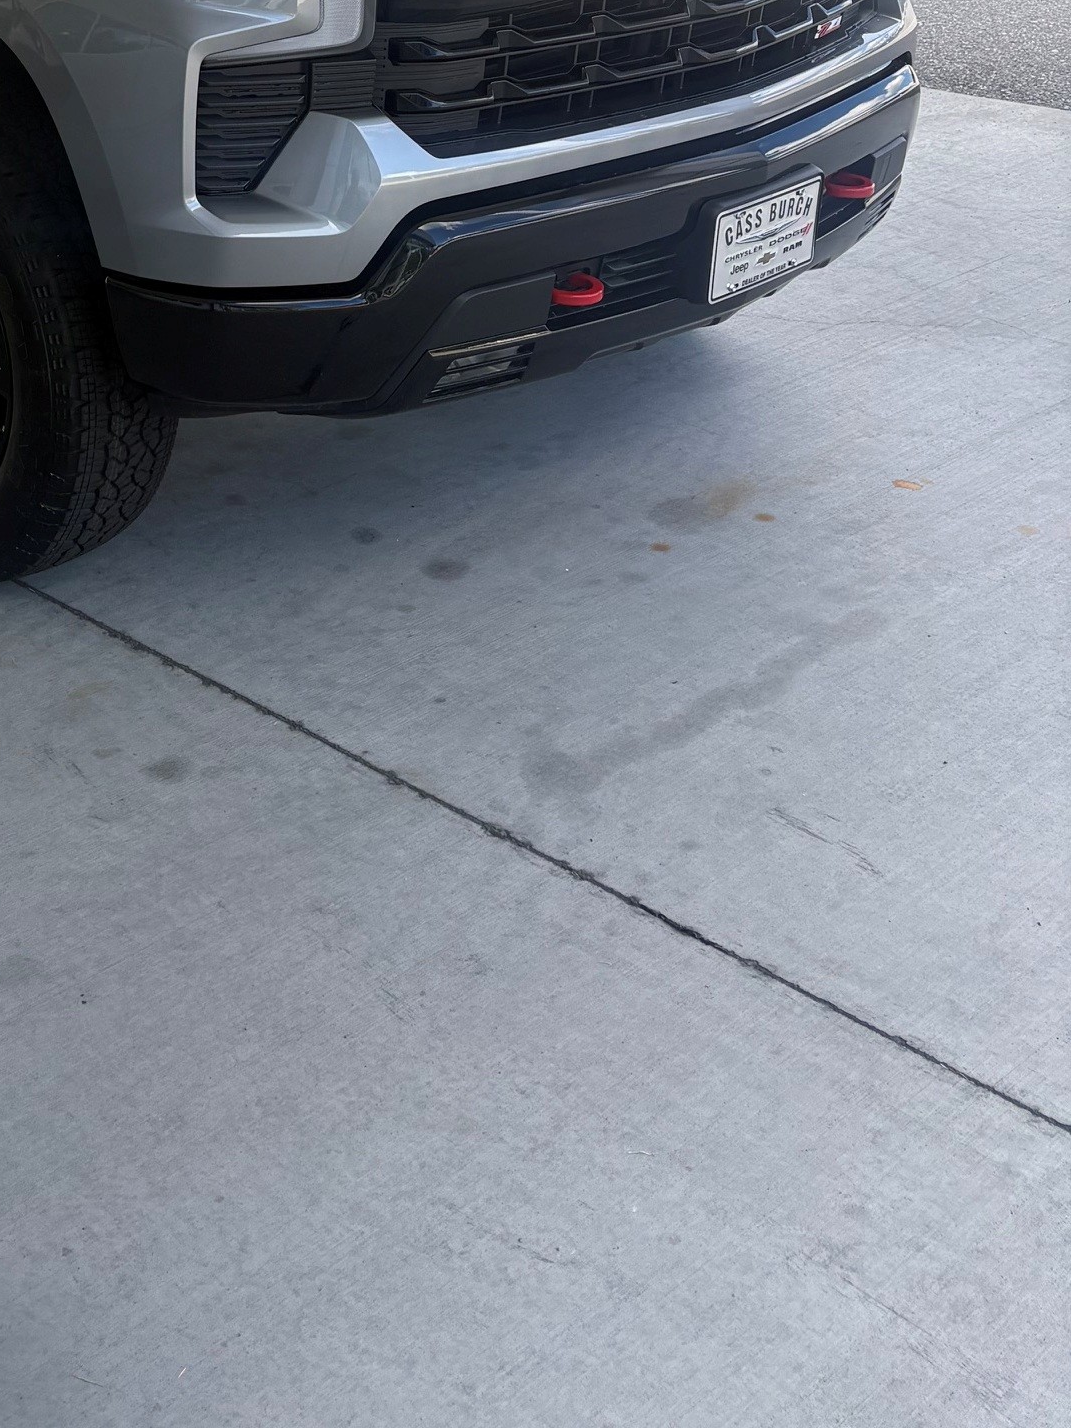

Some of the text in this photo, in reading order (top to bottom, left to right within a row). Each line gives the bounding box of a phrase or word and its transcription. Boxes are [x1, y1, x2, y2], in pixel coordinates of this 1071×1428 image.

[725, 196, 813, 246] CASS BURCH
[724, 245, 763, 263] CHRYSLER
[730, 240, 803, 275] Jeep RAM
